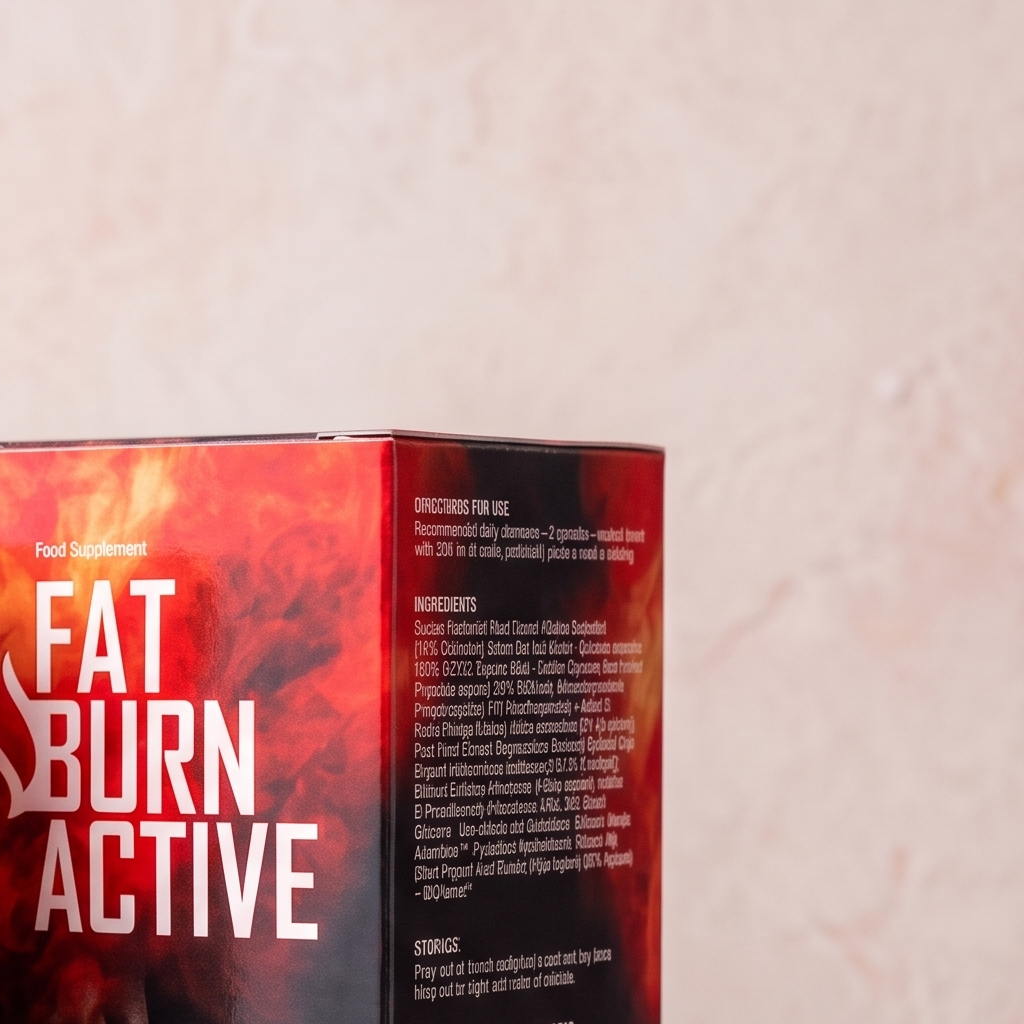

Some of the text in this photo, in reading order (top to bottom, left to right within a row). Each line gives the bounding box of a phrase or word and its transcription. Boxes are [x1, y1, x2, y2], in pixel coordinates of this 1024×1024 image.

[492, 500, 510, 516] USE
[36, 540, 147, 560] Food Supplement
[414, 596, 477, 613] INGREDIENTS
[36, 579, 176, 693] FAT
[24, 699, 255, 816] BURN
[34, 820, 318, 940] ACTIVE
[414, 964, 437, 982] Pray
